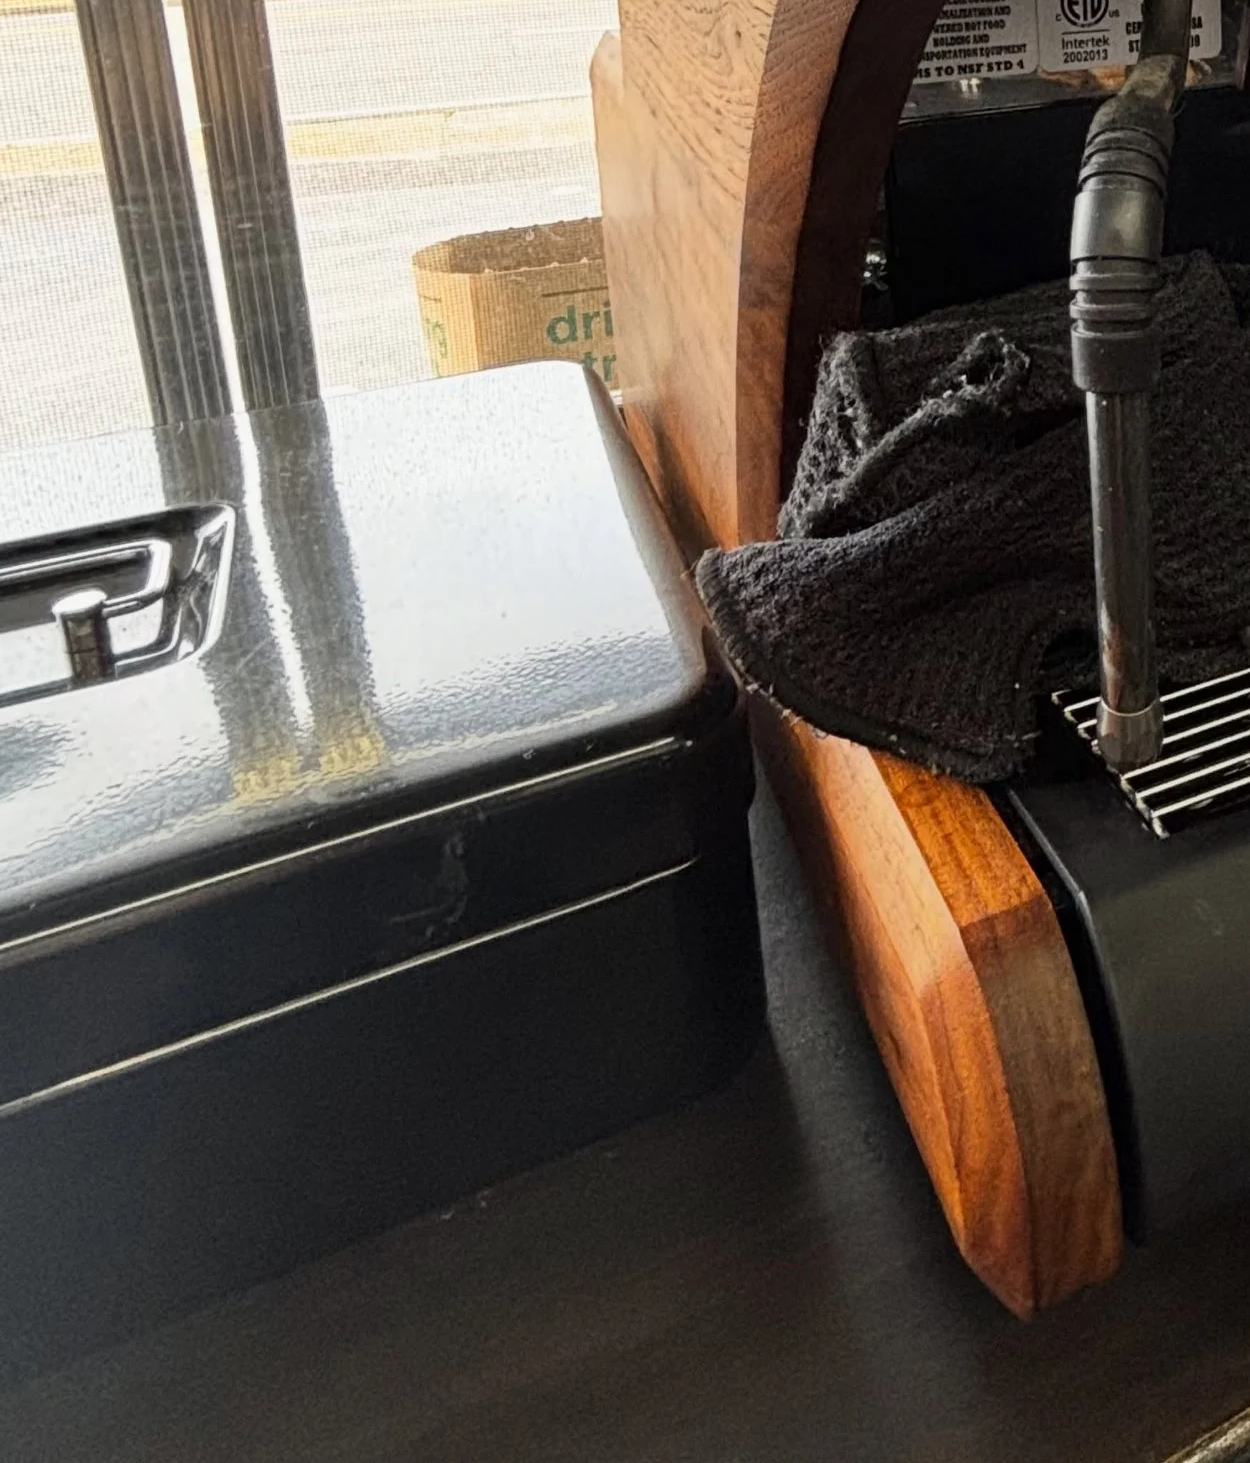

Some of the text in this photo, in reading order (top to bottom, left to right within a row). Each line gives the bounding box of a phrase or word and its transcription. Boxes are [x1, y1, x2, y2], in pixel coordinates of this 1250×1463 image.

[994, 5, 1012, 17] AND
[983, 18, 1006, 30] FOOD
[972, 33, 990, 45] AND
[1061, 34, 1110, 50] Intertek
[1063, 48, 1108, 64] 2002013
[935, 66, 954, 78] TO
[957, 63, 984, 76] NSF
[986, 60, 1013, 73] STD
